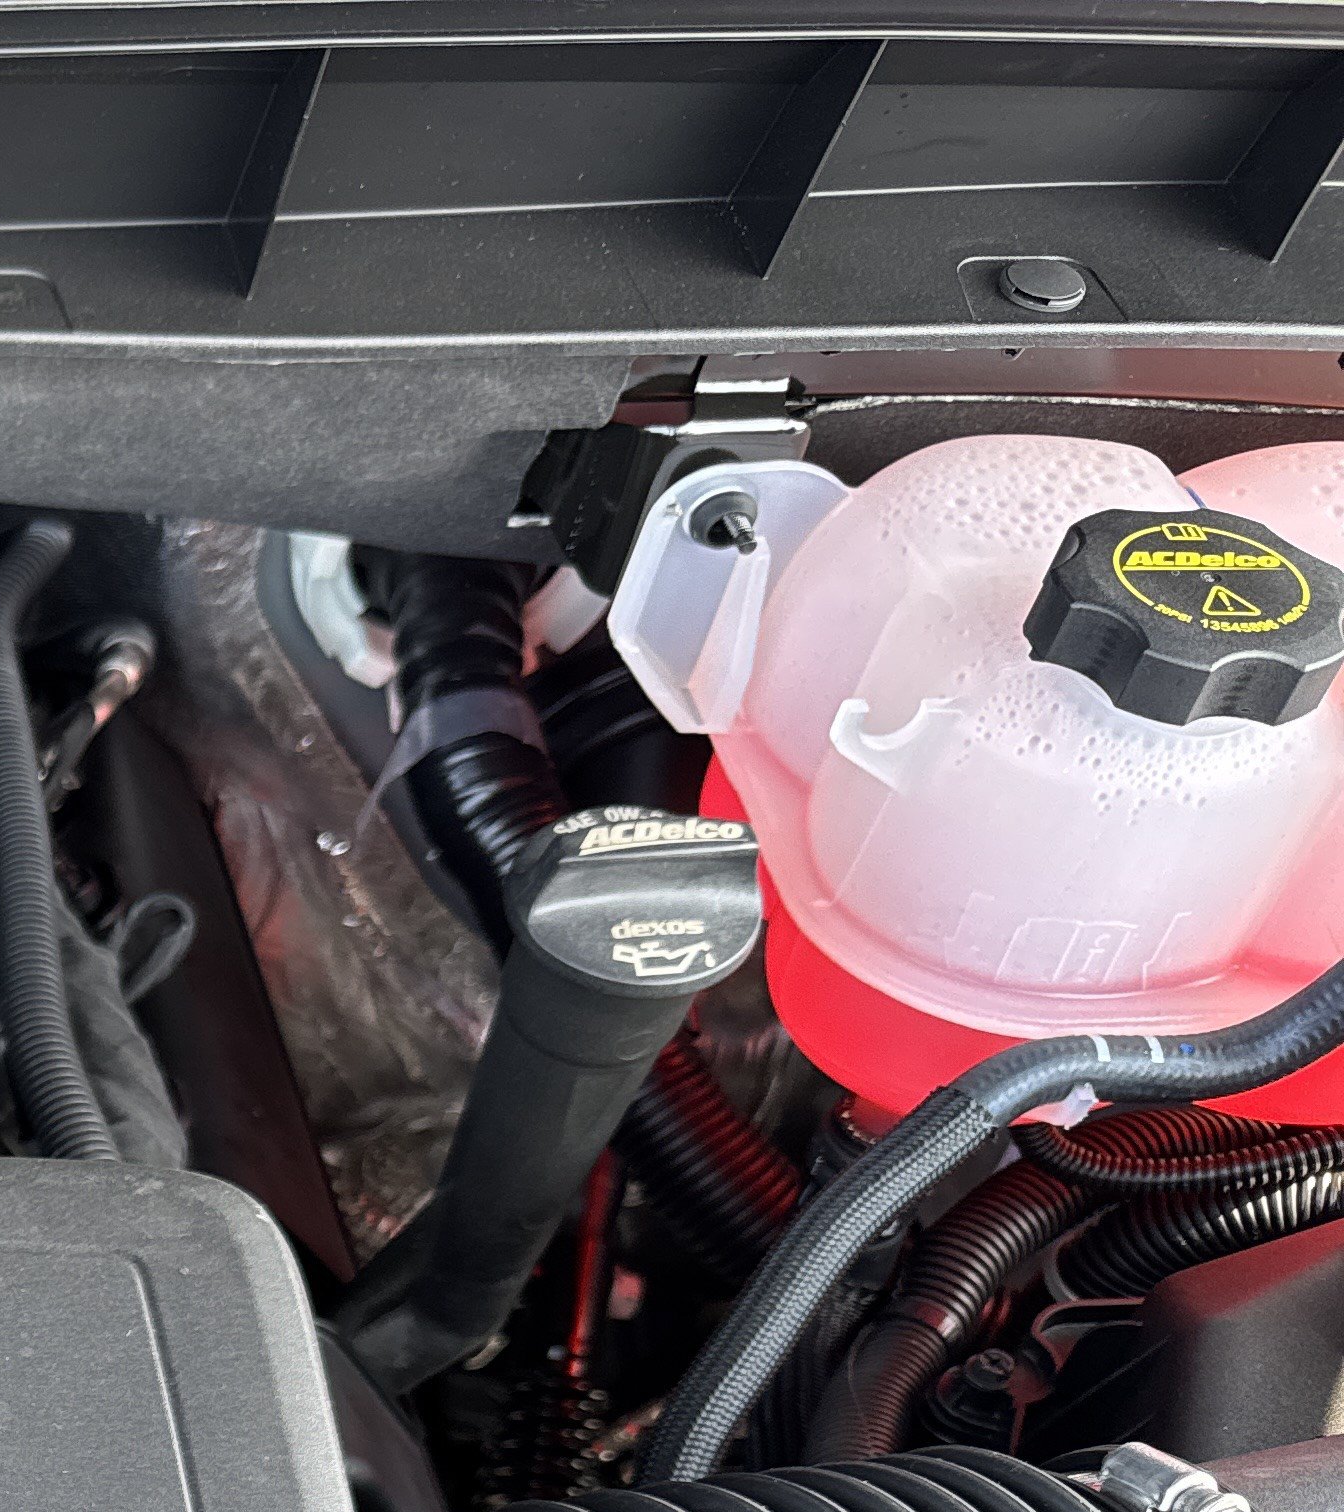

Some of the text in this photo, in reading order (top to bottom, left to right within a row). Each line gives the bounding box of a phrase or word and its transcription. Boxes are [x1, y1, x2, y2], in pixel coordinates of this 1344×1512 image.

[1125, 551, 1281, 568] ACDelco
[552, 811, 600, 836] SAE
[579, 818, 746, 850] ACDelco
[611, 918, 705, 940] dexos
